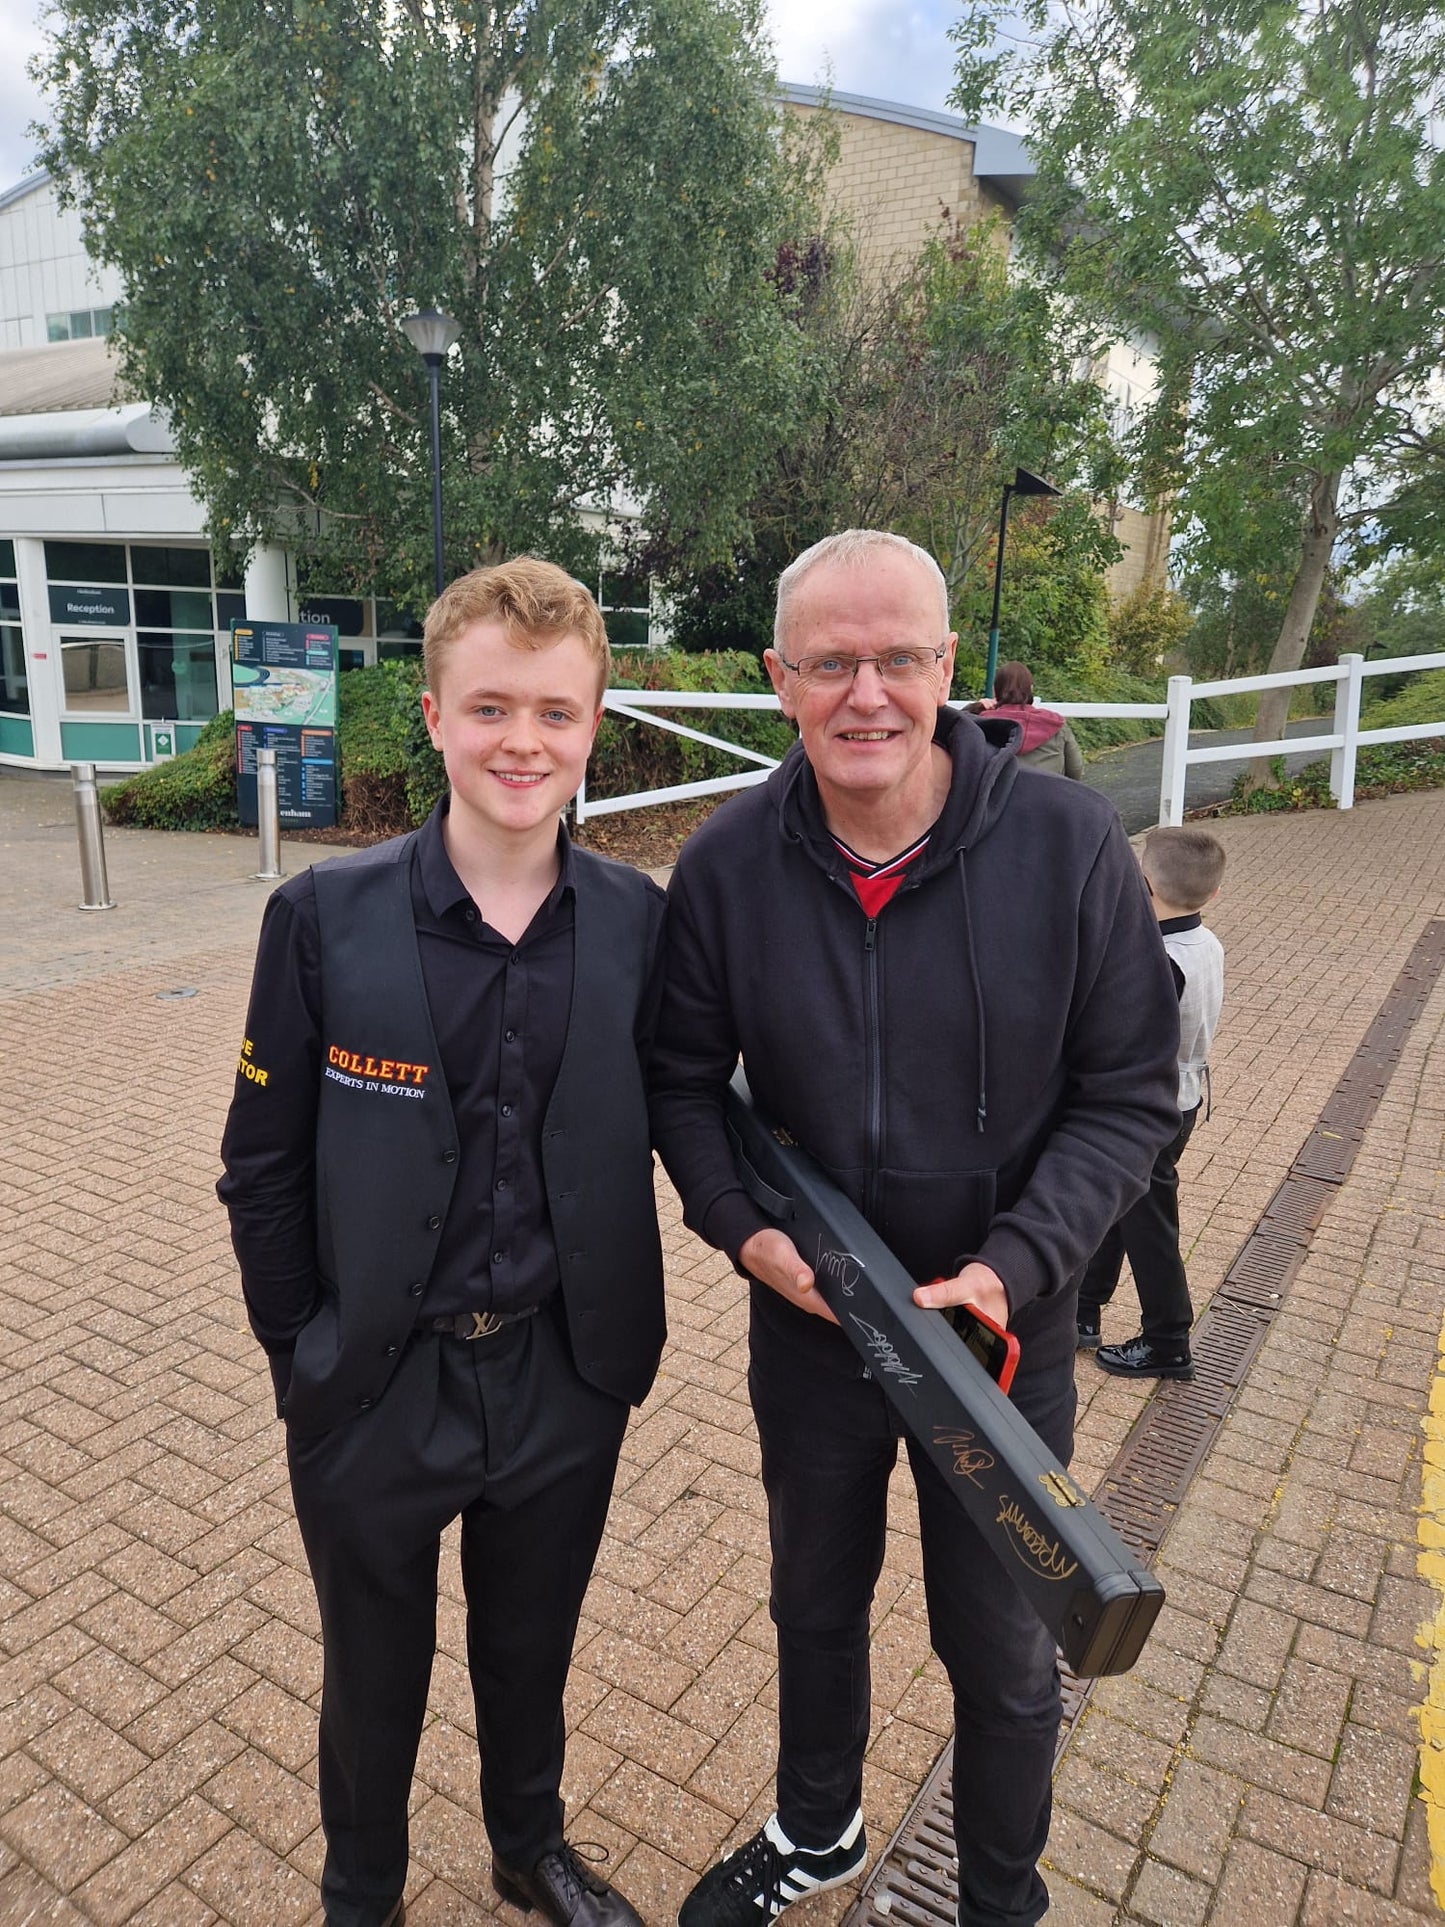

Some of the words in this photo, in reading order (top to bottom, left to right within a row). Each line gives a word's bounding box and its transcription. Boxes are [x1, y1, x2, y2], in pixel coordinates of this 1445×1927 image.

[66, 603, 115, 614] Reception
[300, 610, 331, 624] tion
[280, 808, 311, 818] enham
[328, 1043, 430, 1085] COLLETT
[324, 1066, 364, 1089] EXPERTS
[366, 1081, 379, 1093] IN
[380, 1083, 426, 1099] MOTION
